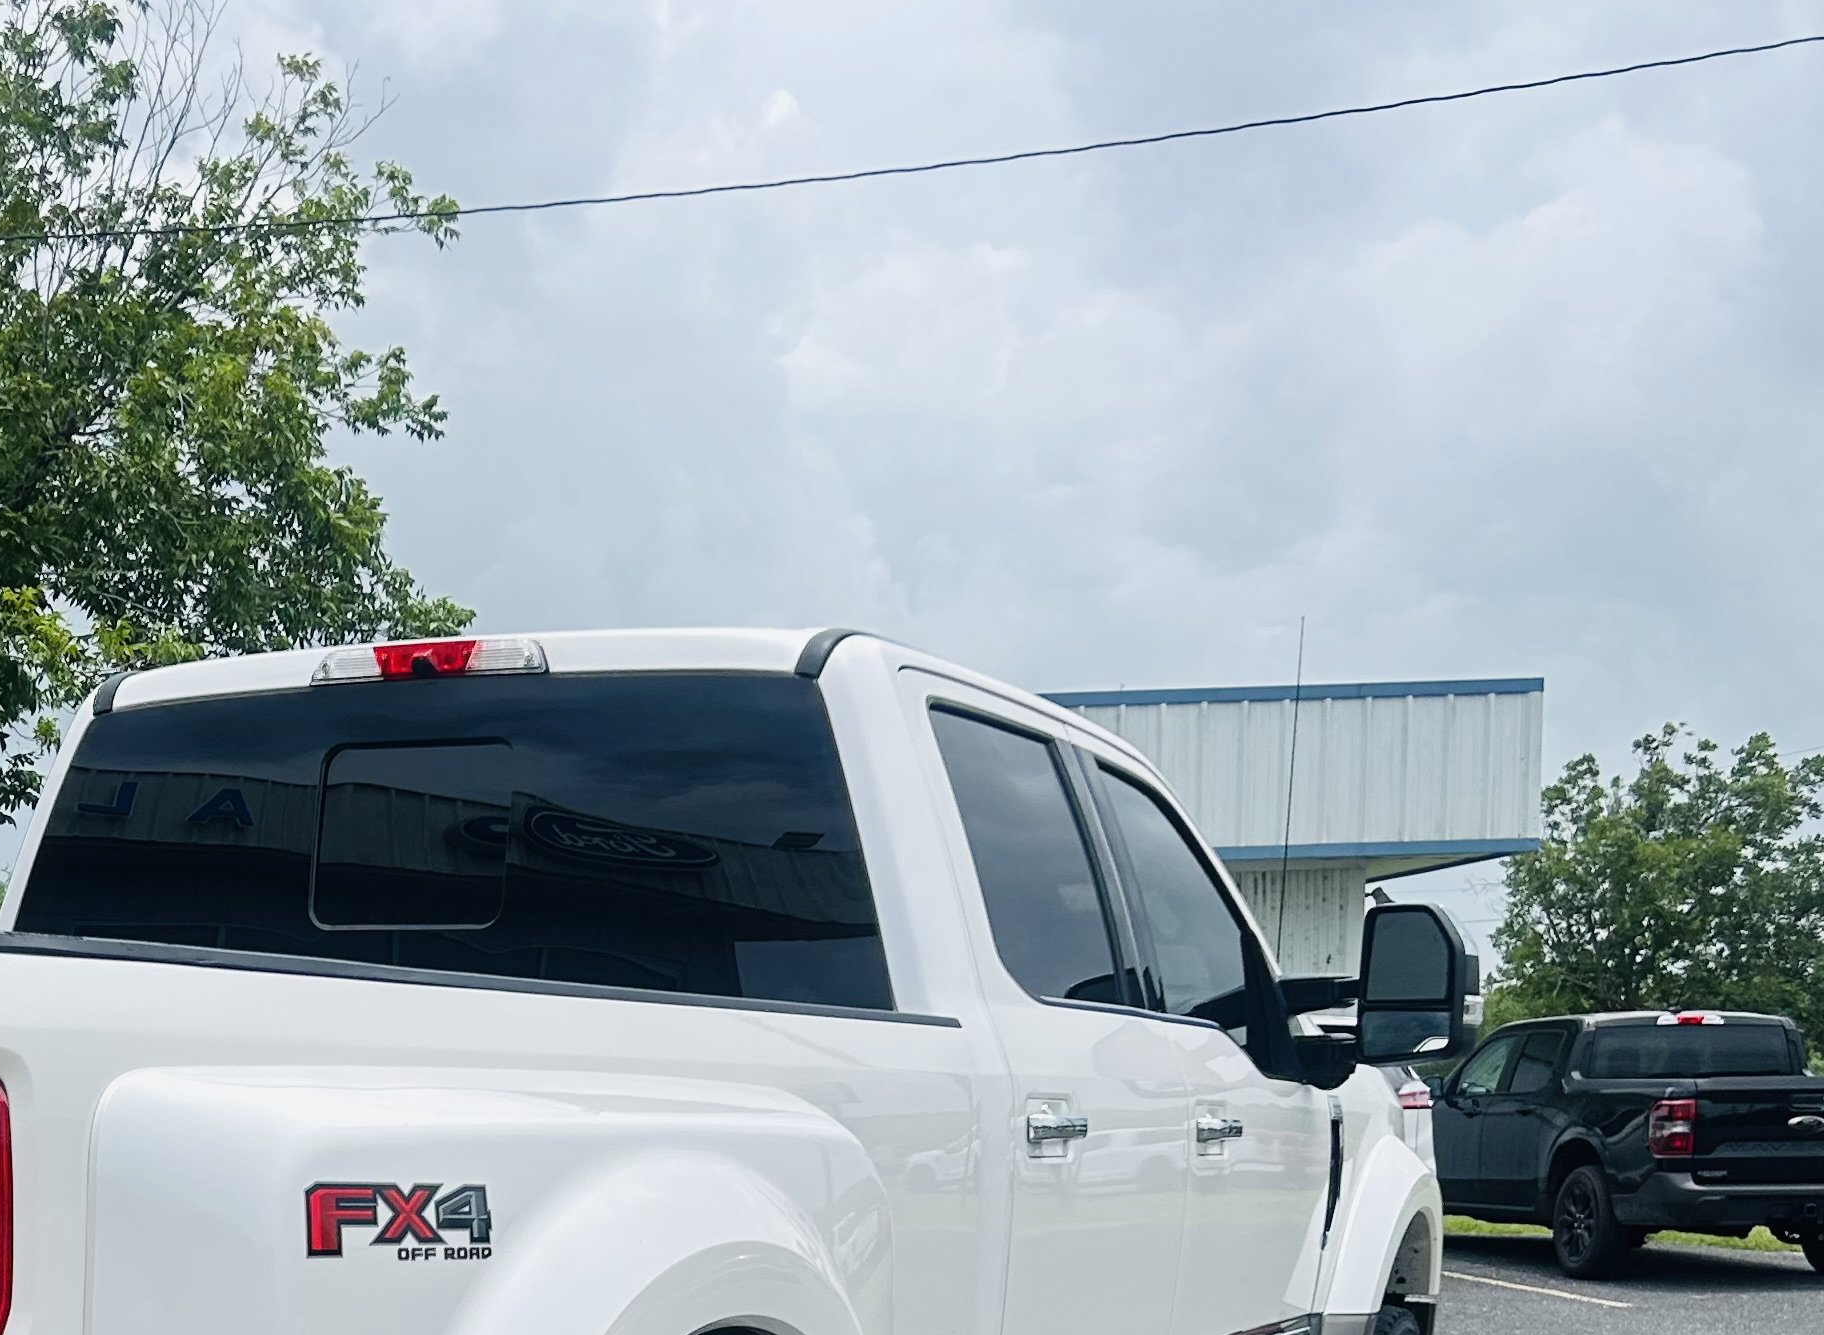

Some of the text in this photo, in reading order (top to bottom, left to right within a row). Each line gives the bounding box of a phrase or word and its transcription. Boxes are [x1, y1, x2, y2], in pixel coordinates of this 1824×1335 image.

[304, 1181, 492, 1259] FX4
[397, 1247, 491, 1260] OFF ROAD
